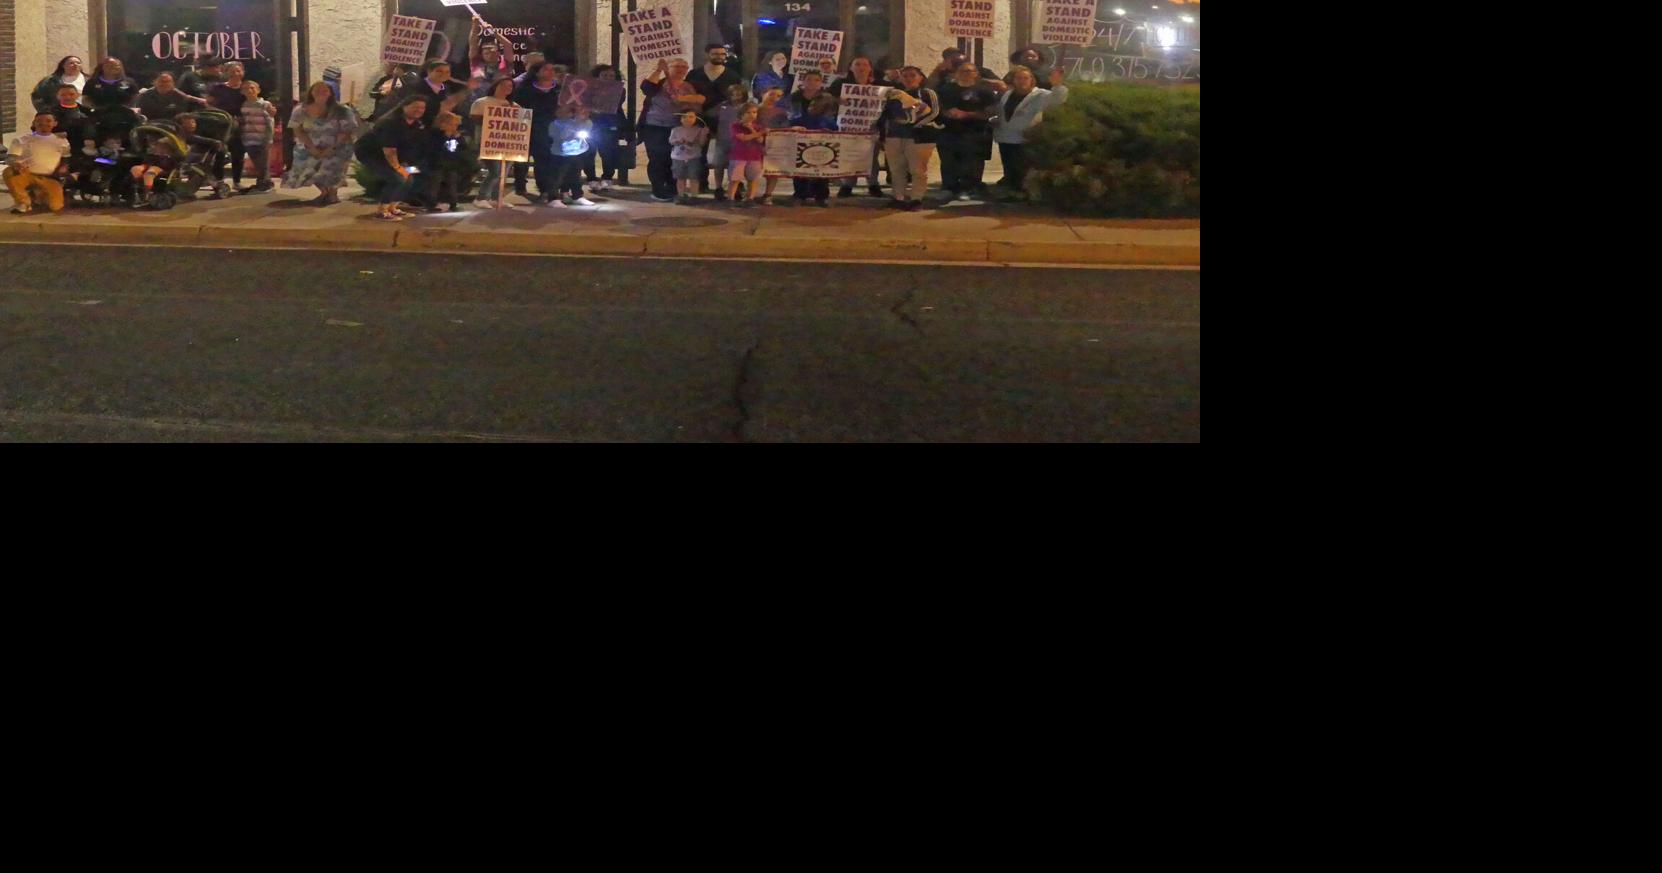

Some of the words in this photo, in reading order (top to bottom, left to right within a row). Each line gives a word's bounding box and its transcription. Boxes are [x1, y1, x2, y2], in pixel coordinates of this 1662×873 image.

[784, 3, 811, 12] 134
[951, 0, 992, 10] STAND
[620, 9, 657, 23] TAKE
[662, 7, 671, 17] A
[953, 11, 990, 19] AGAINST
[1046, 7, 1091, 17] STAND
[393, 17, 422, 29] TAKE
[425, 22, 433, 31] A
[948, 19, 993, 28] DOMESTIC
[1047, 18, 1087, 26] AGAINST
[628, 20, 672, 35] STAND
[950, 28, 993, 37] VIOLENCE
[1042, 25, 1090, 34] DOMESTIC
[391, 28, 428, 41] STAND
[634, 30, 674, 43] AGAINST
[798, 29, 829, 40] TAKE
[832, 33, 841, 42] A
[1042, 34, 1088, 42] VIOLENCE
[151, 31, 265, 60] OCTOBER
[390, 39, 424, 48] AGAINST
[633, 39, 681, 53] DOMESTIC
[797, 41, 837, 52] STAND
[385, 46, 424, 56] DOMESTIC
[637, 48, 682, 61] VIOLENCE
[384, 53, 420, 63] VIOLENCE
[846, 98, 881, 108] STAN
[487, 106, 519, 118] TAKE
[523, 111, 531, 121] A
[487, 120, 528, 132] STAND
[840, 118, 870, 126] DOME
[488, 132, 525, 141] AGAINST
[485, 141, 528, 151] DOMESTIC
